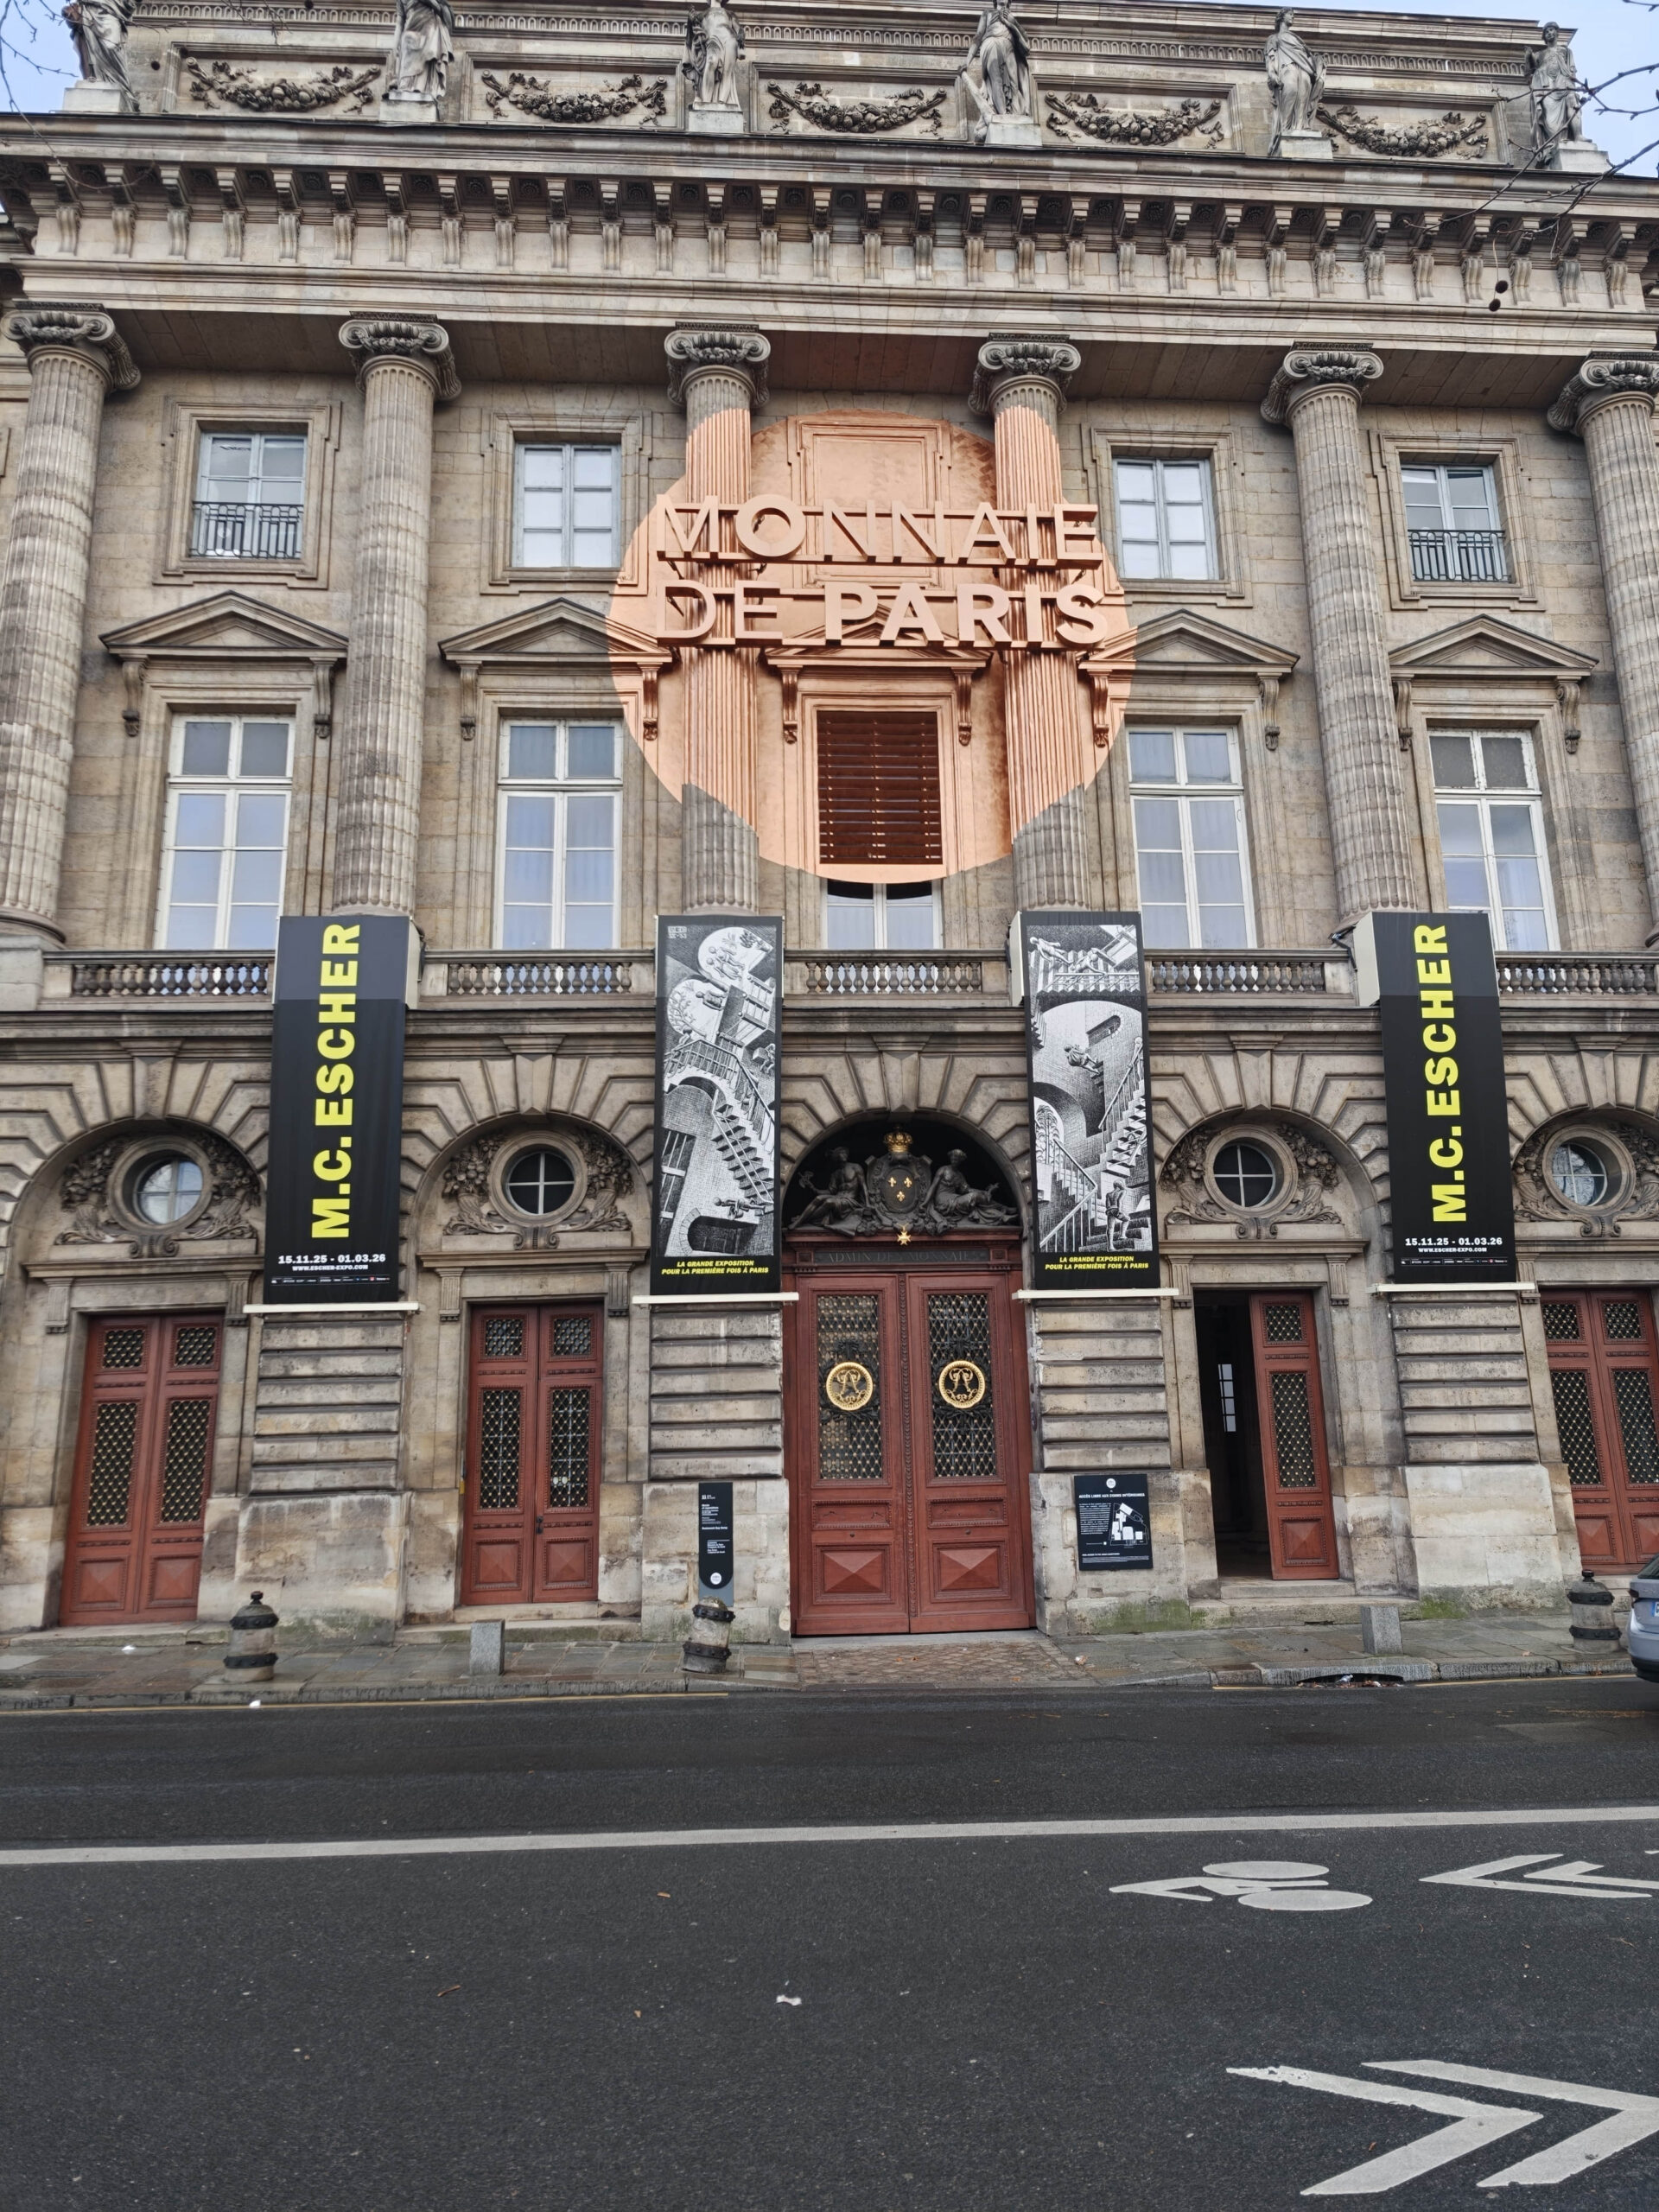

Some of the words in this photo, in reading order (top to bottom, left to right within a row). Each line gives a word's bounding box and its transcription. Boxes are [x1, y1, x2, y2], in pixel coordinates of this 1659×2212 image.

[656, 493, 1104, 569] MONNAIE
[657, 578, 783, 645] DE
[824, 582, 1109, 649] PARIS
[315, 924, 361, 1127] ESCHER
[1414, 925, 1462, 1116] ESCHER
[311, 1135, 353, 1239] M.C.
[1429, 1125, 1467, 1223] M.C.
[278, 1255, 327, 1264] 15.11.25
[338, 1254, 386, 1263] 01.03.26
[1405, 1237, 1449, 1246] 15.11.25
[1459, 1237, 1503, 1246] 01.03.26
